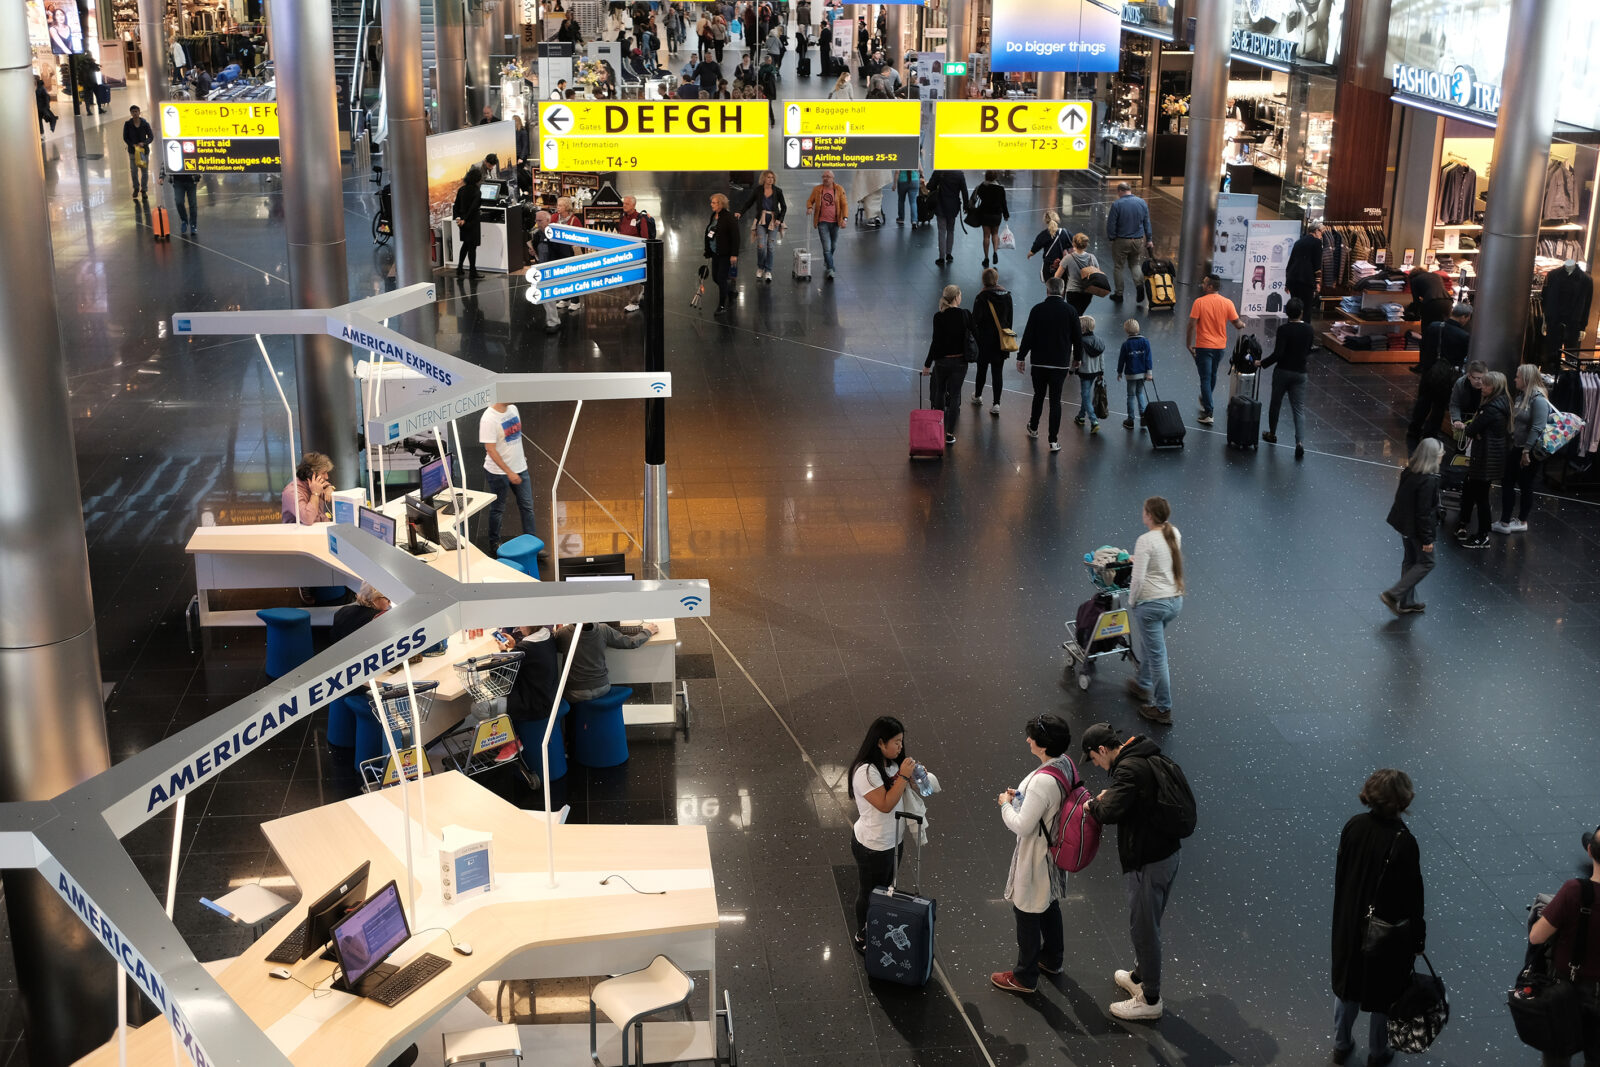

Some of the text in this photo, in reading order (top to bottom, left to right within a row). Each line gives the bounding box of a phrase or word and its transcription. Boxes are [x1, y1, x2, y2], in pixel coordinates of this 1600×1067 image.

[524, 0, 532, 42] SUNGLAS
[1006, 40, 1106, 55] Do bigger things
[1242, 30, 1250, 51] &
[1250, 33, 1294, 62] JEWELRY
[1393, 64, 1450, 100] FASHION
[220, 106, 230, 118] D
[232, 124, 265, 135] T4-9
[1030, 139, 1058, 150] T2-3
[227, 157, 259, 166] lounges
[606, 157, 638, 168] T4-9
[843, 154, 874, 162] lounges
[562, 232, 590, 243] Foodcourt
[553, 252, 633, 276] Mediterranean Sandwich
[553, 285, 573, 295] Grand
[575, 282, 590, 291] Café
[604, 275, 623, 285] Paleis
[342, 326, 452, 386] AMERICAN EXPRESS
[406, 389, 490, 433] INTERNET CENTRE
[146, 627, 427, 813] AMERICAN EXPRESS
[59, 872, 166, 1011] AMERICAN
[171, 1001, 210, 1067] EXP
